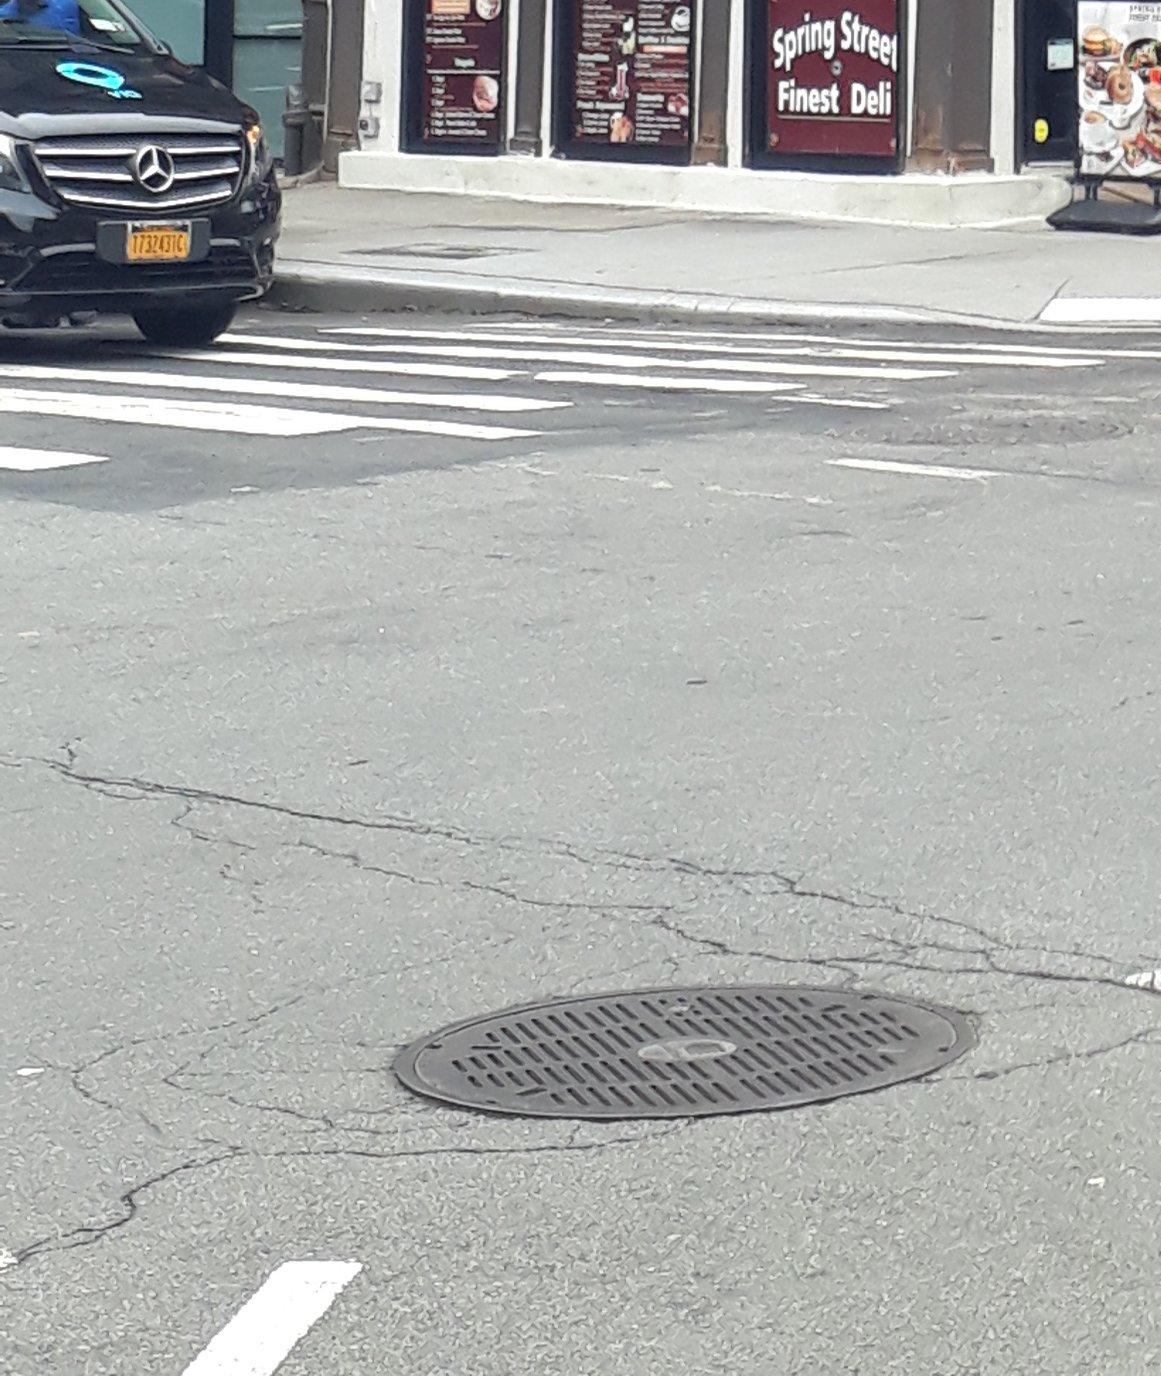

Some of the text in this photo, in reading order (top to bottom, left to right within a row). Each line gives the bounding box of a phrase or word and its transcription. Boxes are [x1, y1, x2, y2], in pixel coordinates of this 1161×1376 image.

[773, 10, 897, 72] Spring Street
[777, 78, 892, 116] Finest Deli
